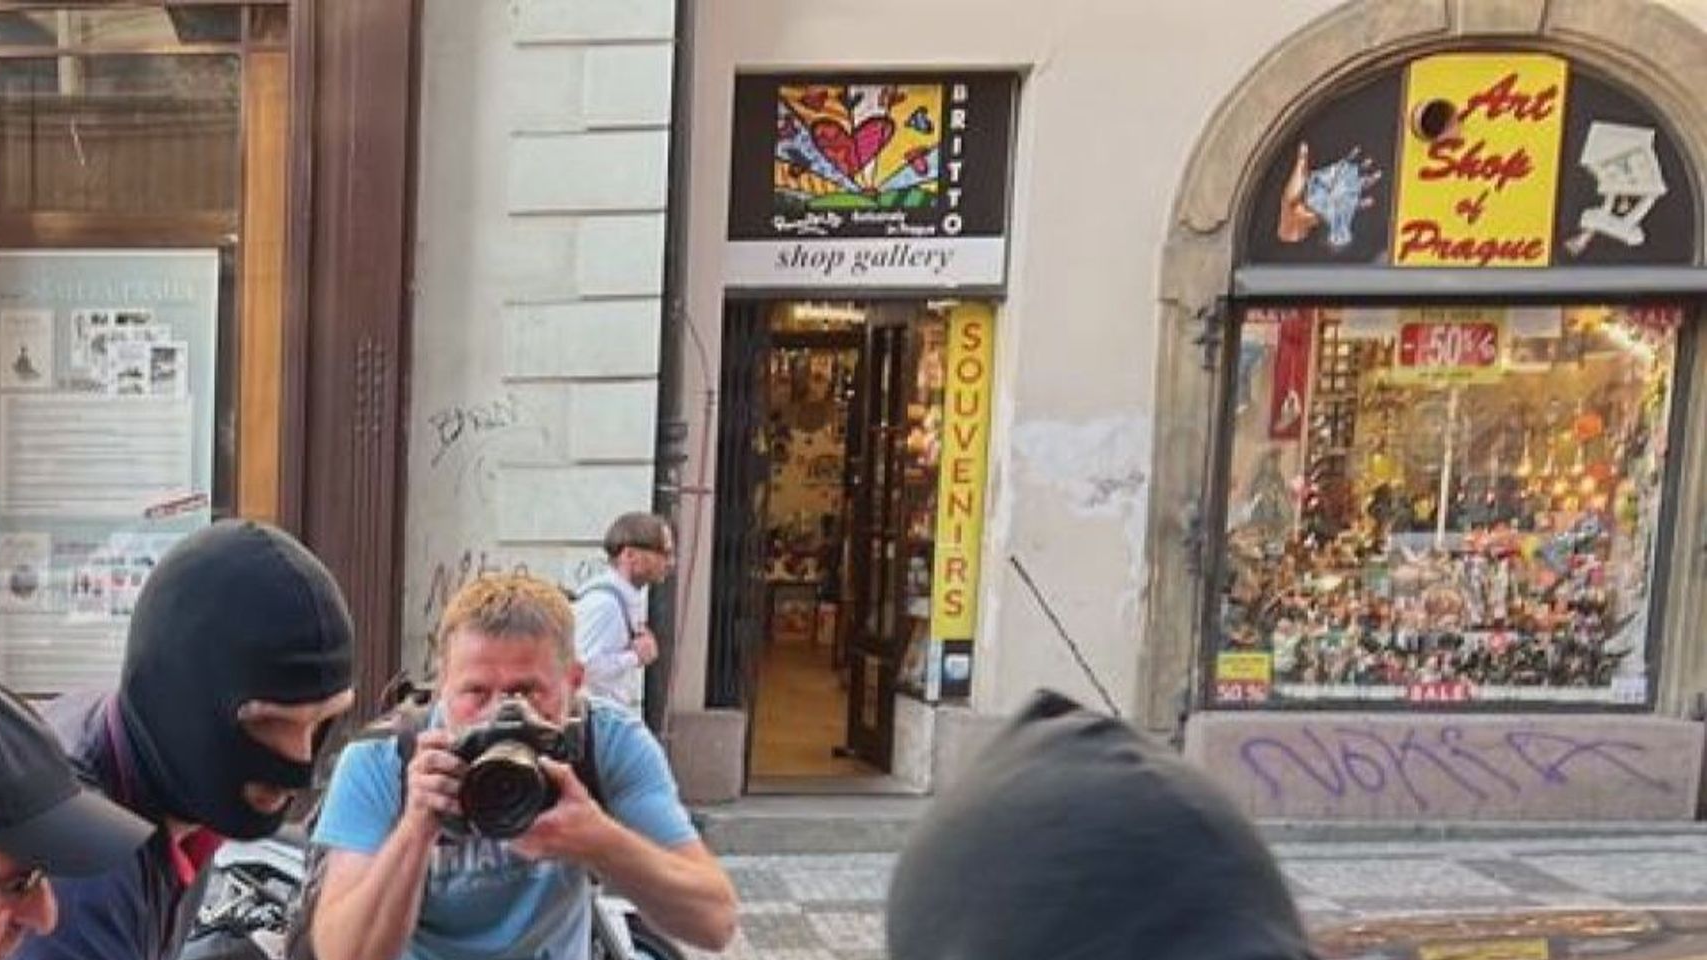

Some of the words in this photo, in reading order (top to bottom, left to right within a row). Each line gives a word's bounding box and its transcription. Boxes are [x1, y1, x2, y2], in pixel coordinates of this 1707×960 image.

[1458, 73, 1558, 121] Art
[943, 83, 968, 235] BRITTO
[1418, 138, 1534, 192] Shop
[1456, 188, 1489, 225] of
[775, 244, 844, 276] shop
[851, 244, 954, 276] gallery
[1399, 219, 1543, 267] Prague
[944, 322, 983, 616] SOUVENIRS
